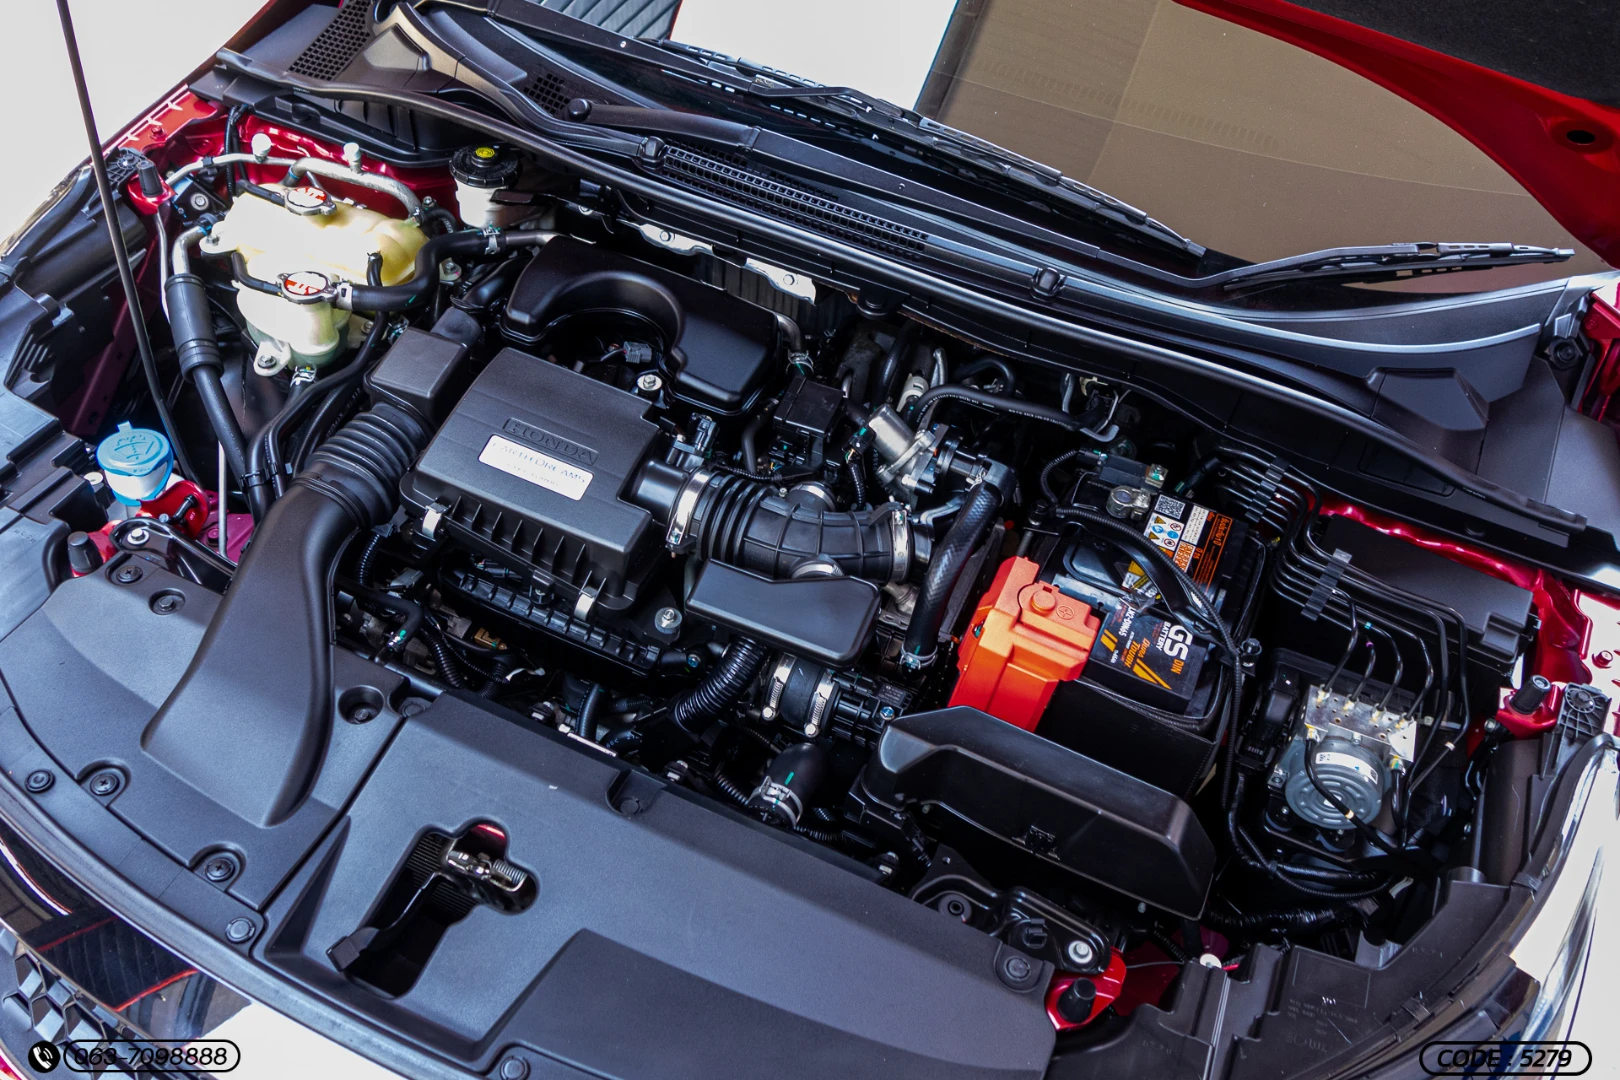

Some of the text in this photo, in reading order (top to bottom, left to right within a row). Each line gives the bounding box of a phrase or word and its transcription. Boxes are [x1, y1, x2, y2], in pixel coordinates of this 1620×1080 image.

[509, 422, 594, 466] HONDA
[1137, 637, 1150, 658] DURA
[1156, 621, 1171, 651] BATTERY
[1163, 624, 1193, 660] GS
[1124, 640, 1140, 668] TOUGH
[1170, 658, 1185, 675] DIN
